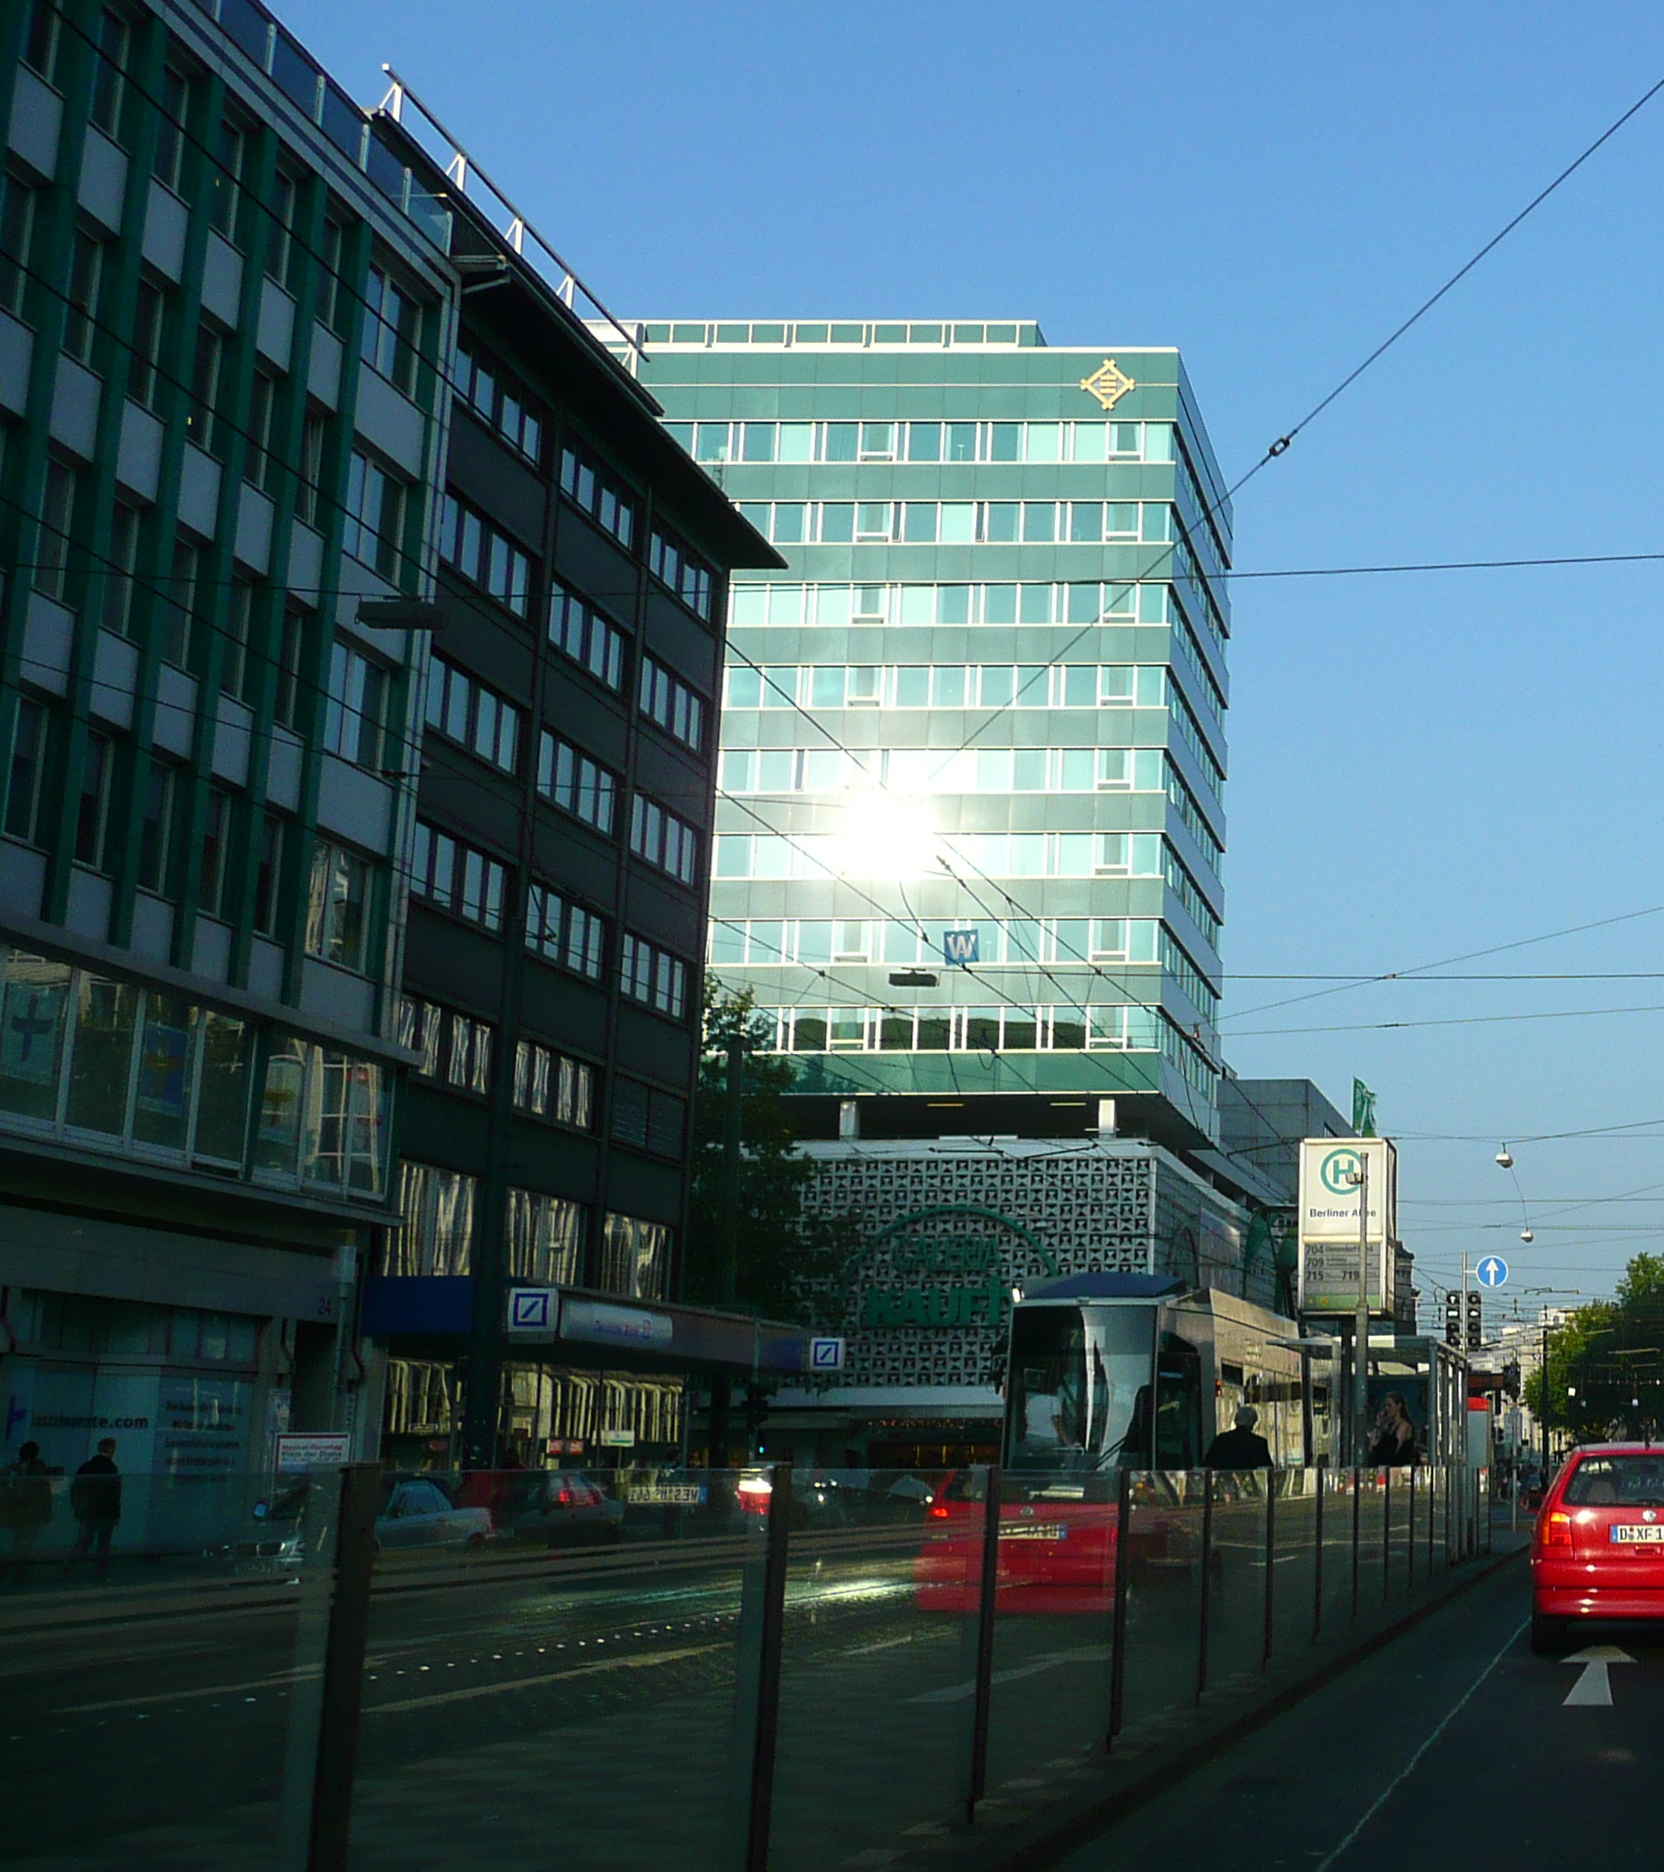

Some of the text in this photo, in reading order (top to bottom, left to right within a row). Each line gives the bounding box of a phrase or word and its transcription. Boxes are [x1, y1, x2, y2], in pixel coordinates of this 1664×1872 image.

[1309, 1208, 1349, 1218] Berliner
[892, 1235, 999, 1271] GALERIA
[1306, 1258, 1324, 1267] 709
[1306, 1271, 1324, 1281] 715
[1342, 1271, 1360, 1281] 719
[1619, 1528, 1628, 1540] D
[1636, 1527, 1653, 1540] XF
